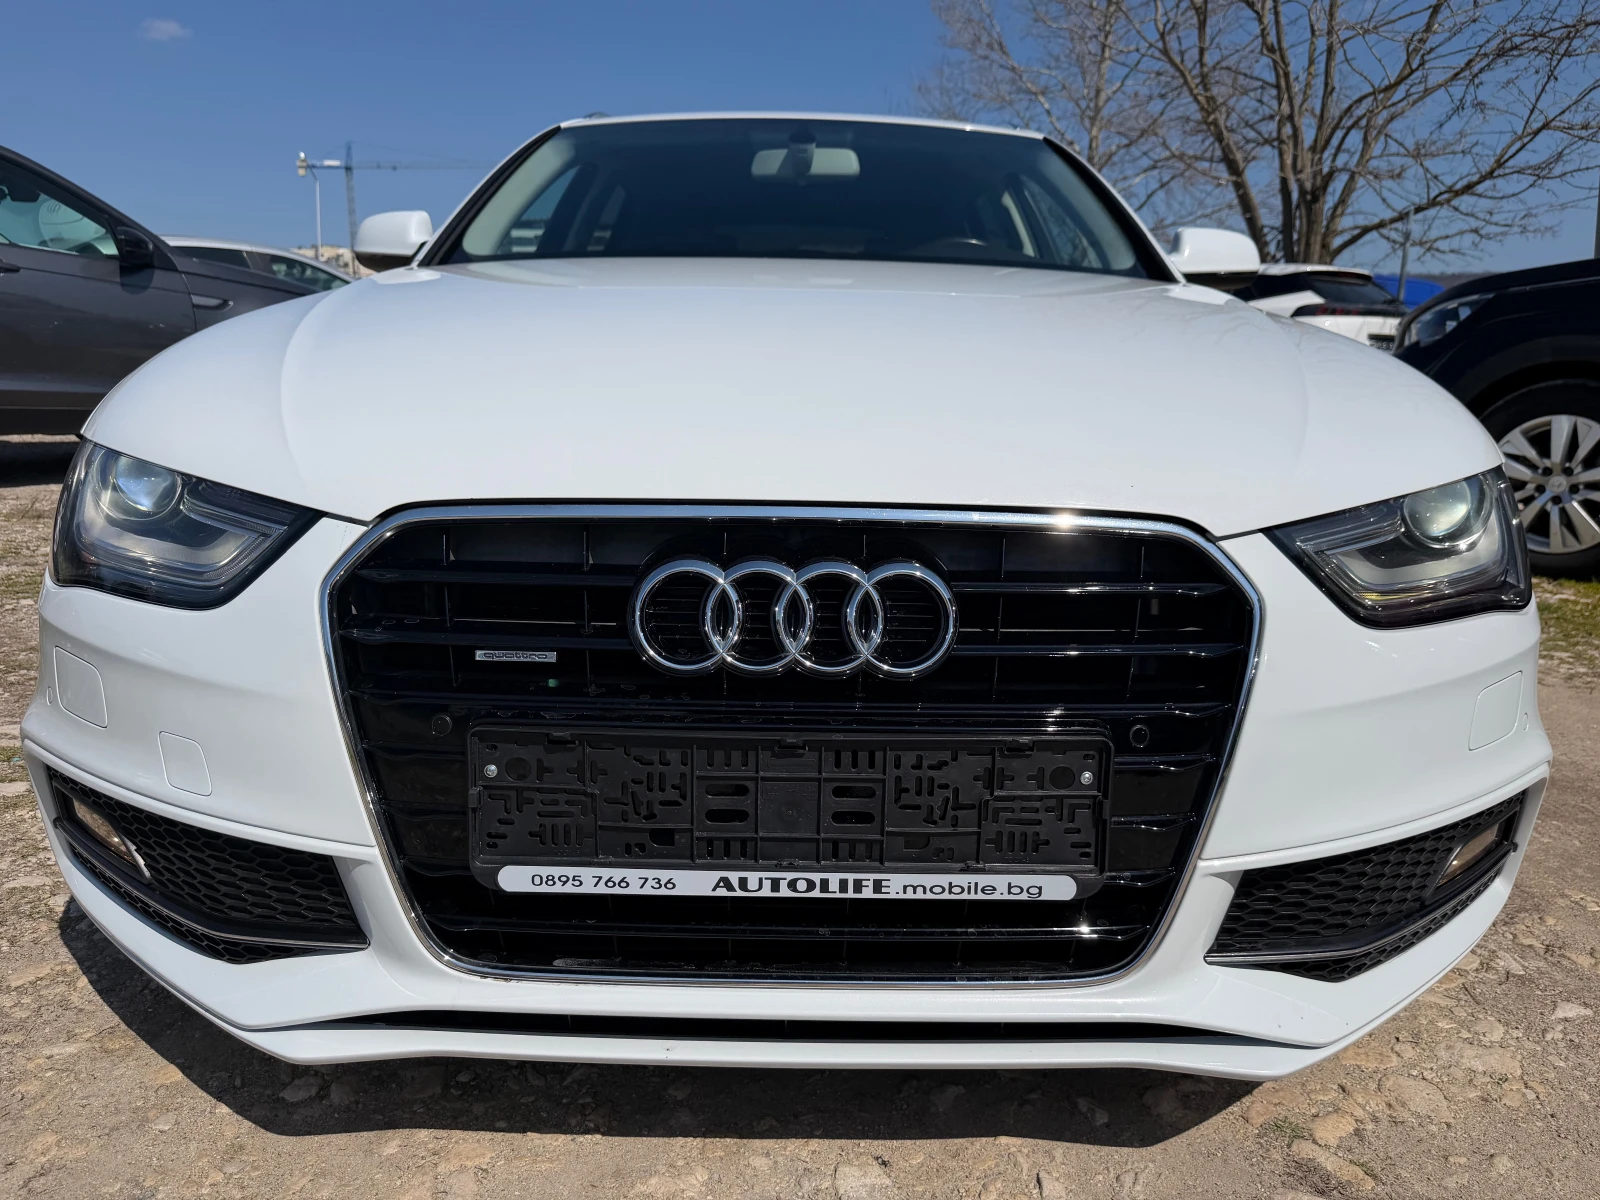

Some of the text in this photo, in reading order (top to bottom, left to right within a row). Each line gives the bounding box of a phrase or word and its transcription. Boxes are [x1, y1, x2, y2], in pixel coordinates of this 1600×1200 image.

[483, 651, 548, 660] quattro
[531, 873, 584, 888] 0895
[591, 875, 630, 889] 766
[637, 876, 677, 891] 736
